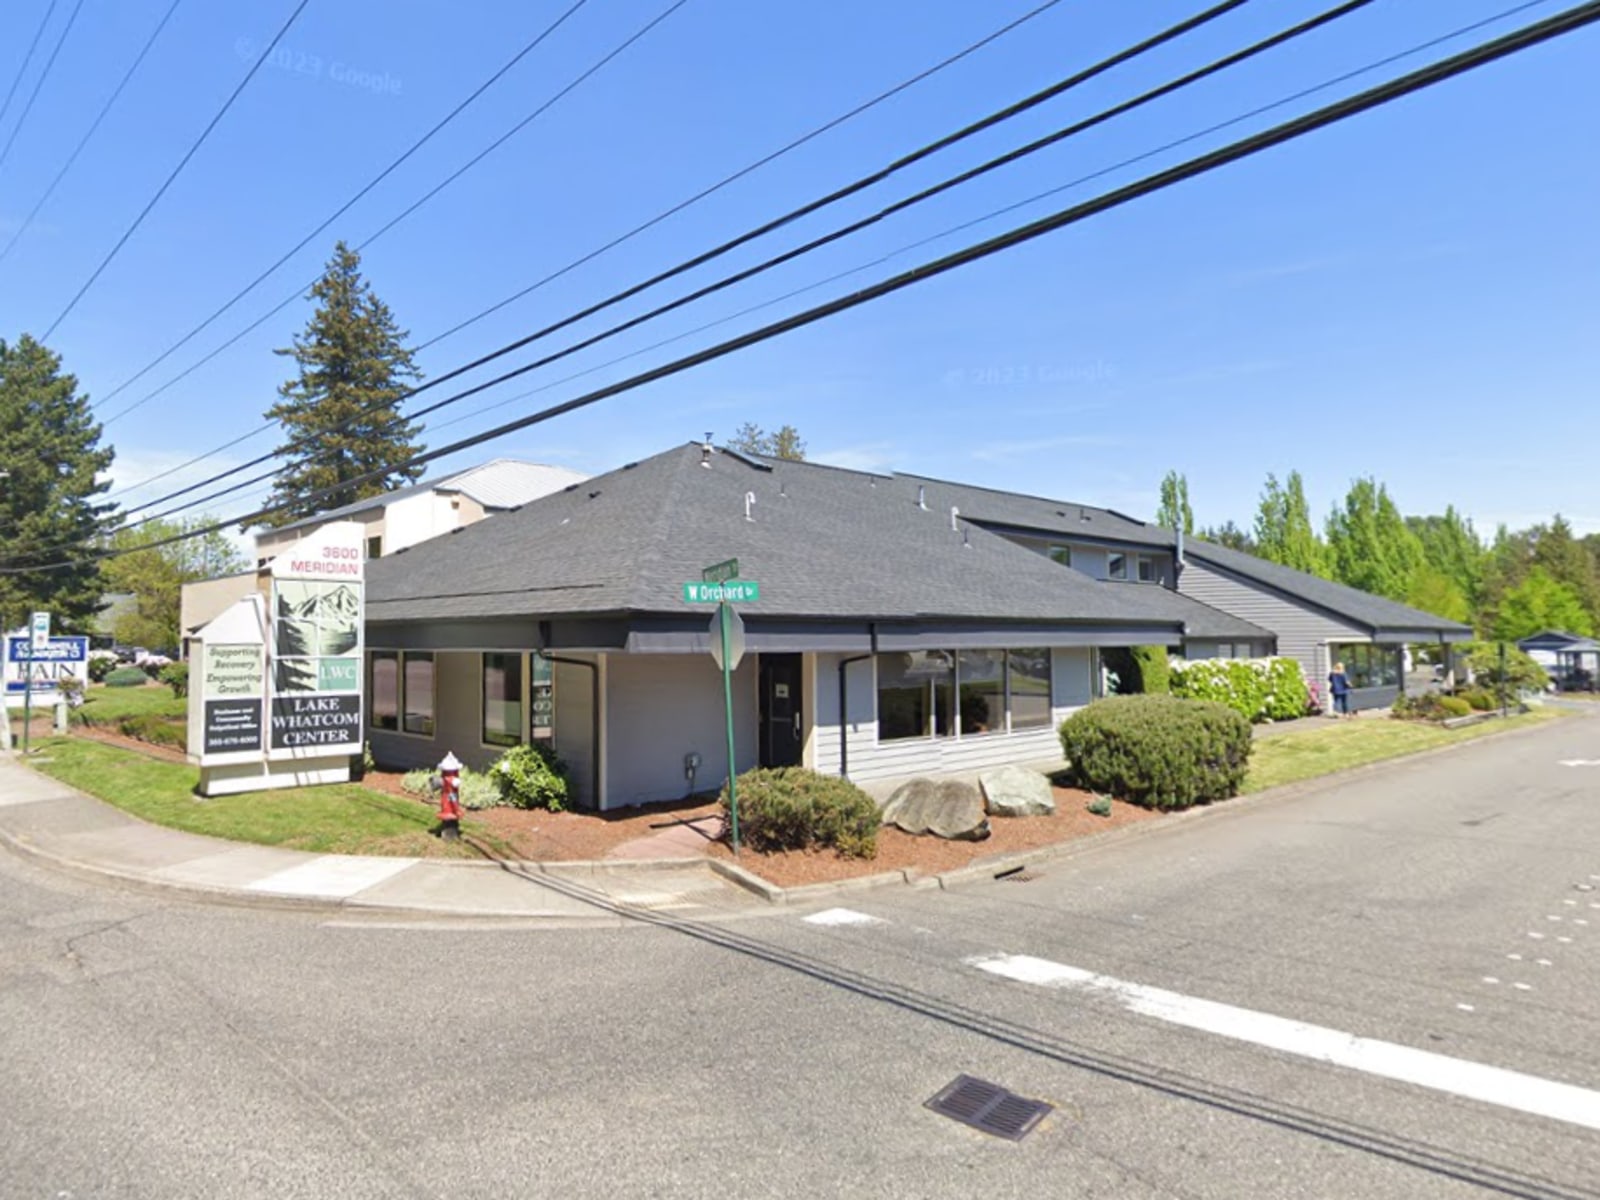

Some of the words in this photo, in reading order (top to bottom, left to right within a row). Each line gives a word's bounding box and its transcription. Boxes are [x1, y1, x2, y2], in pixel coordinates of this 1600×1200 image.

[323, 547, 358, 559] 3600
[291, 561, 358, 574] MERIDIAN
[688, 585, 698, 600] W
[700, 585, 744, 600] Orchard
[209, 647, 260, 658] Supporting
[214, 660, 255, 670] Recovery
[207, 673, 262, 684] Empowering
[321, 666, 355, 680] LWC
[218, 684, 251, 693] Growth
[295, 698, 340, 712] LAKE
[272, 713, 359, 729] WHATCOM
[283, 730, 349, 746] CENTER
